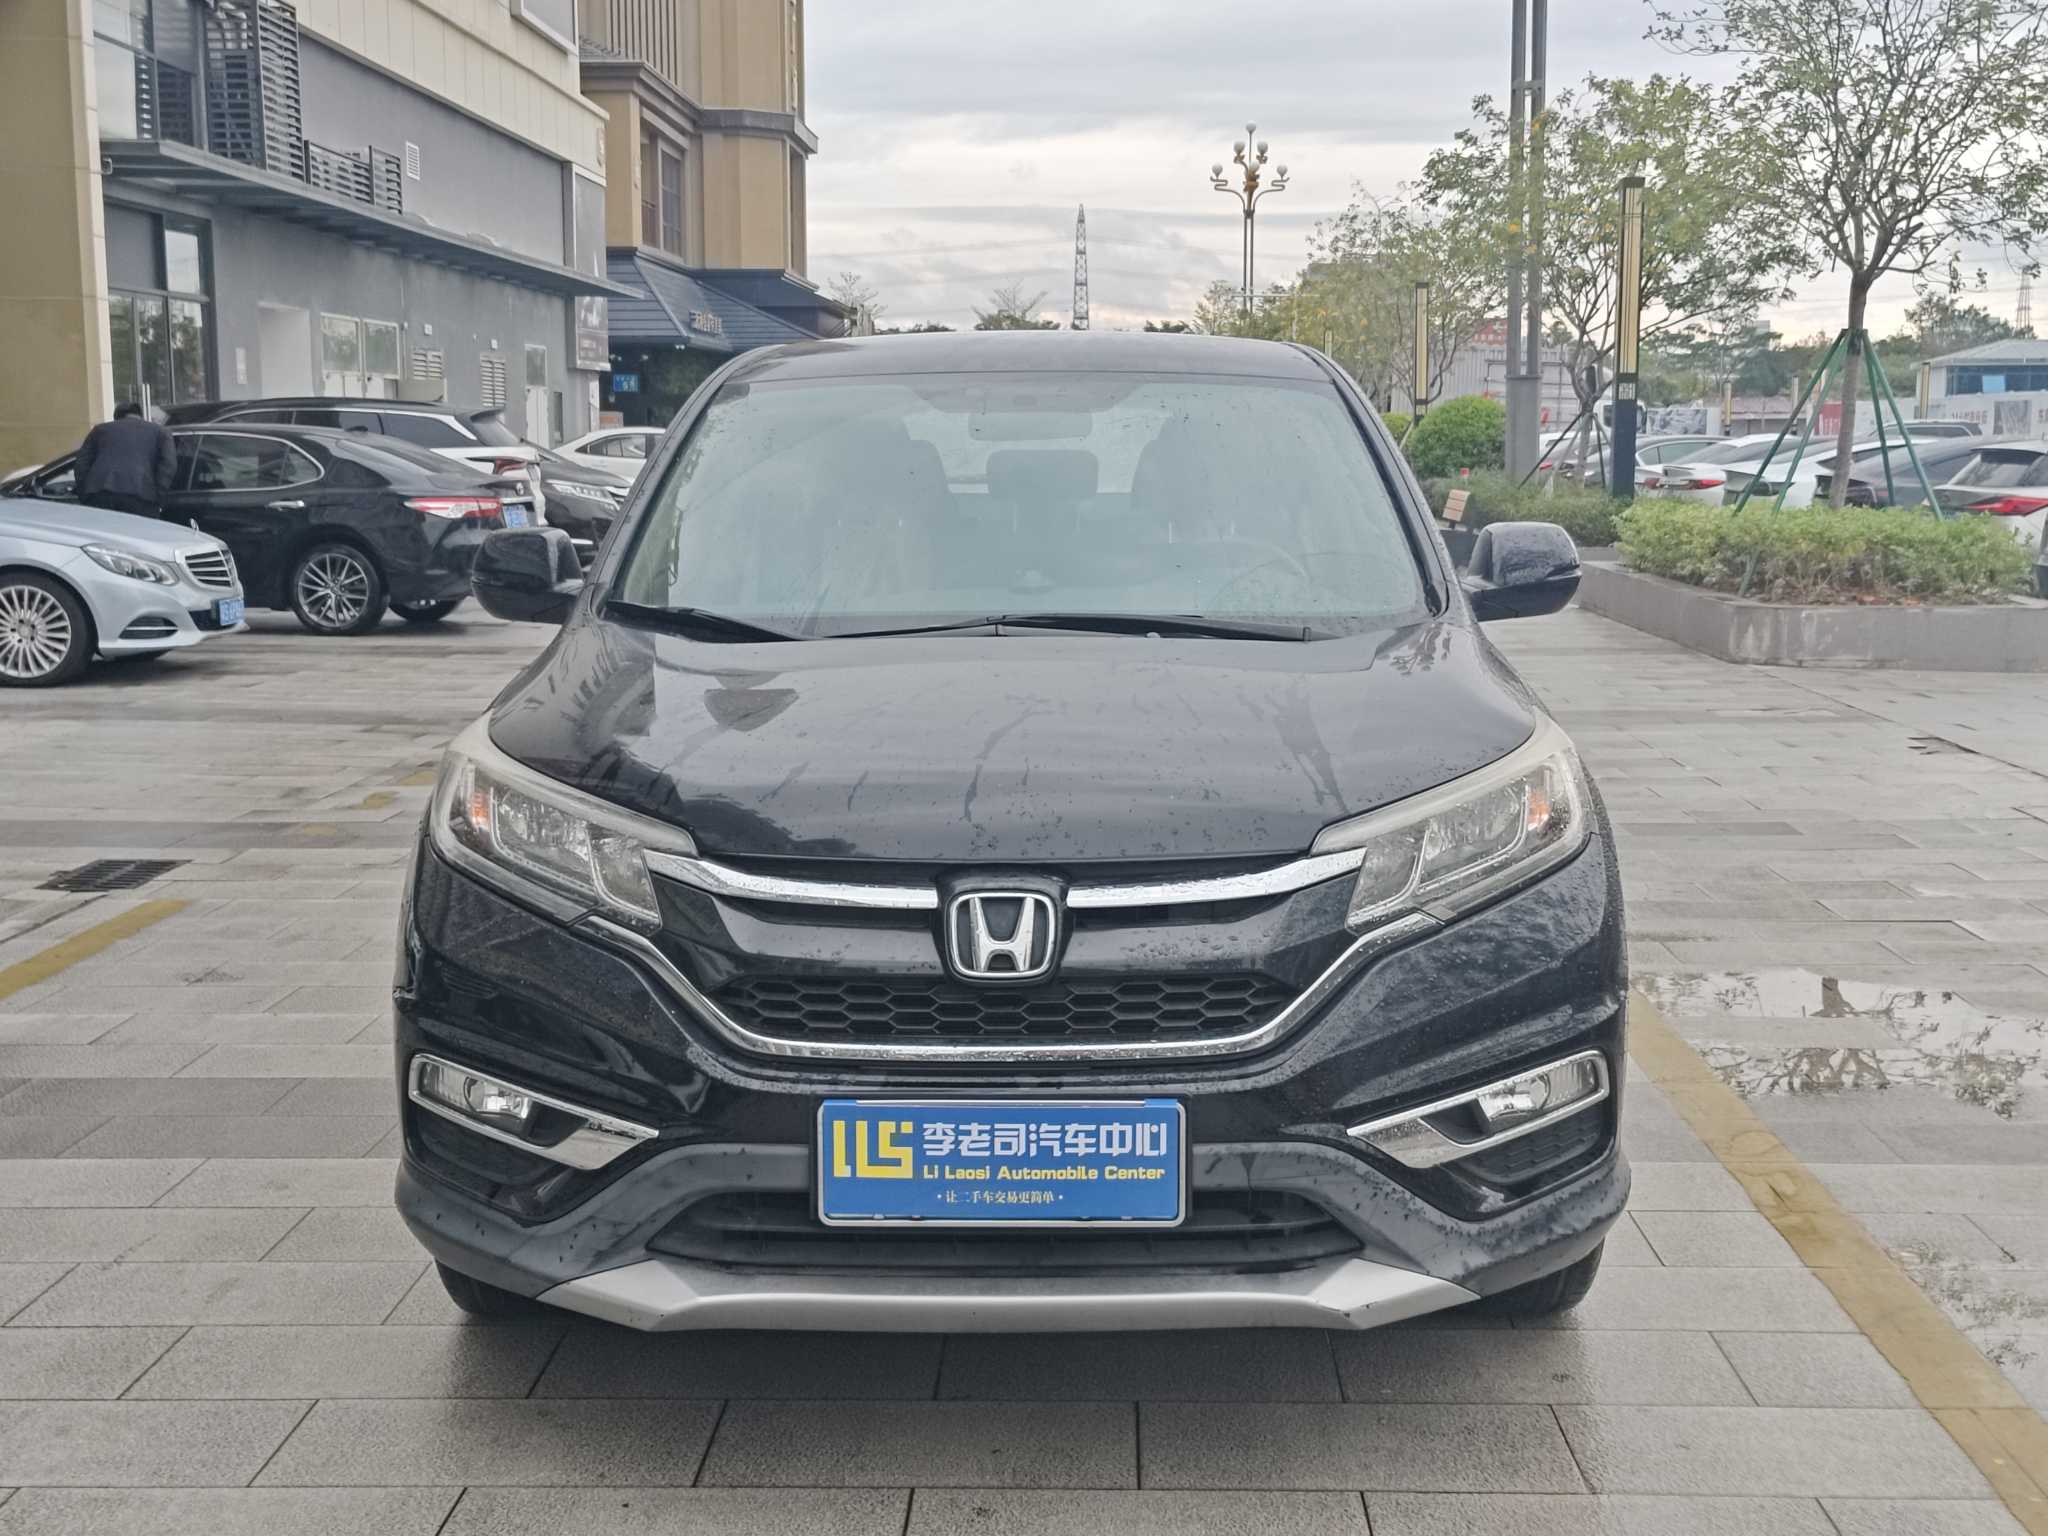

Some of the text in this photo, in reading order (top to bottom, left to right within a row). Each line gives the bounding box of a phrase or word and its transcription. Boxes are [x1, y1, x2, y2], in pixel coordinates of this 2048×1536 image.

[923, 1122, 1167, 1157] 李老司汽车中心
[923, 1164, 1166, 1180] Li Laosi Automobile Center
